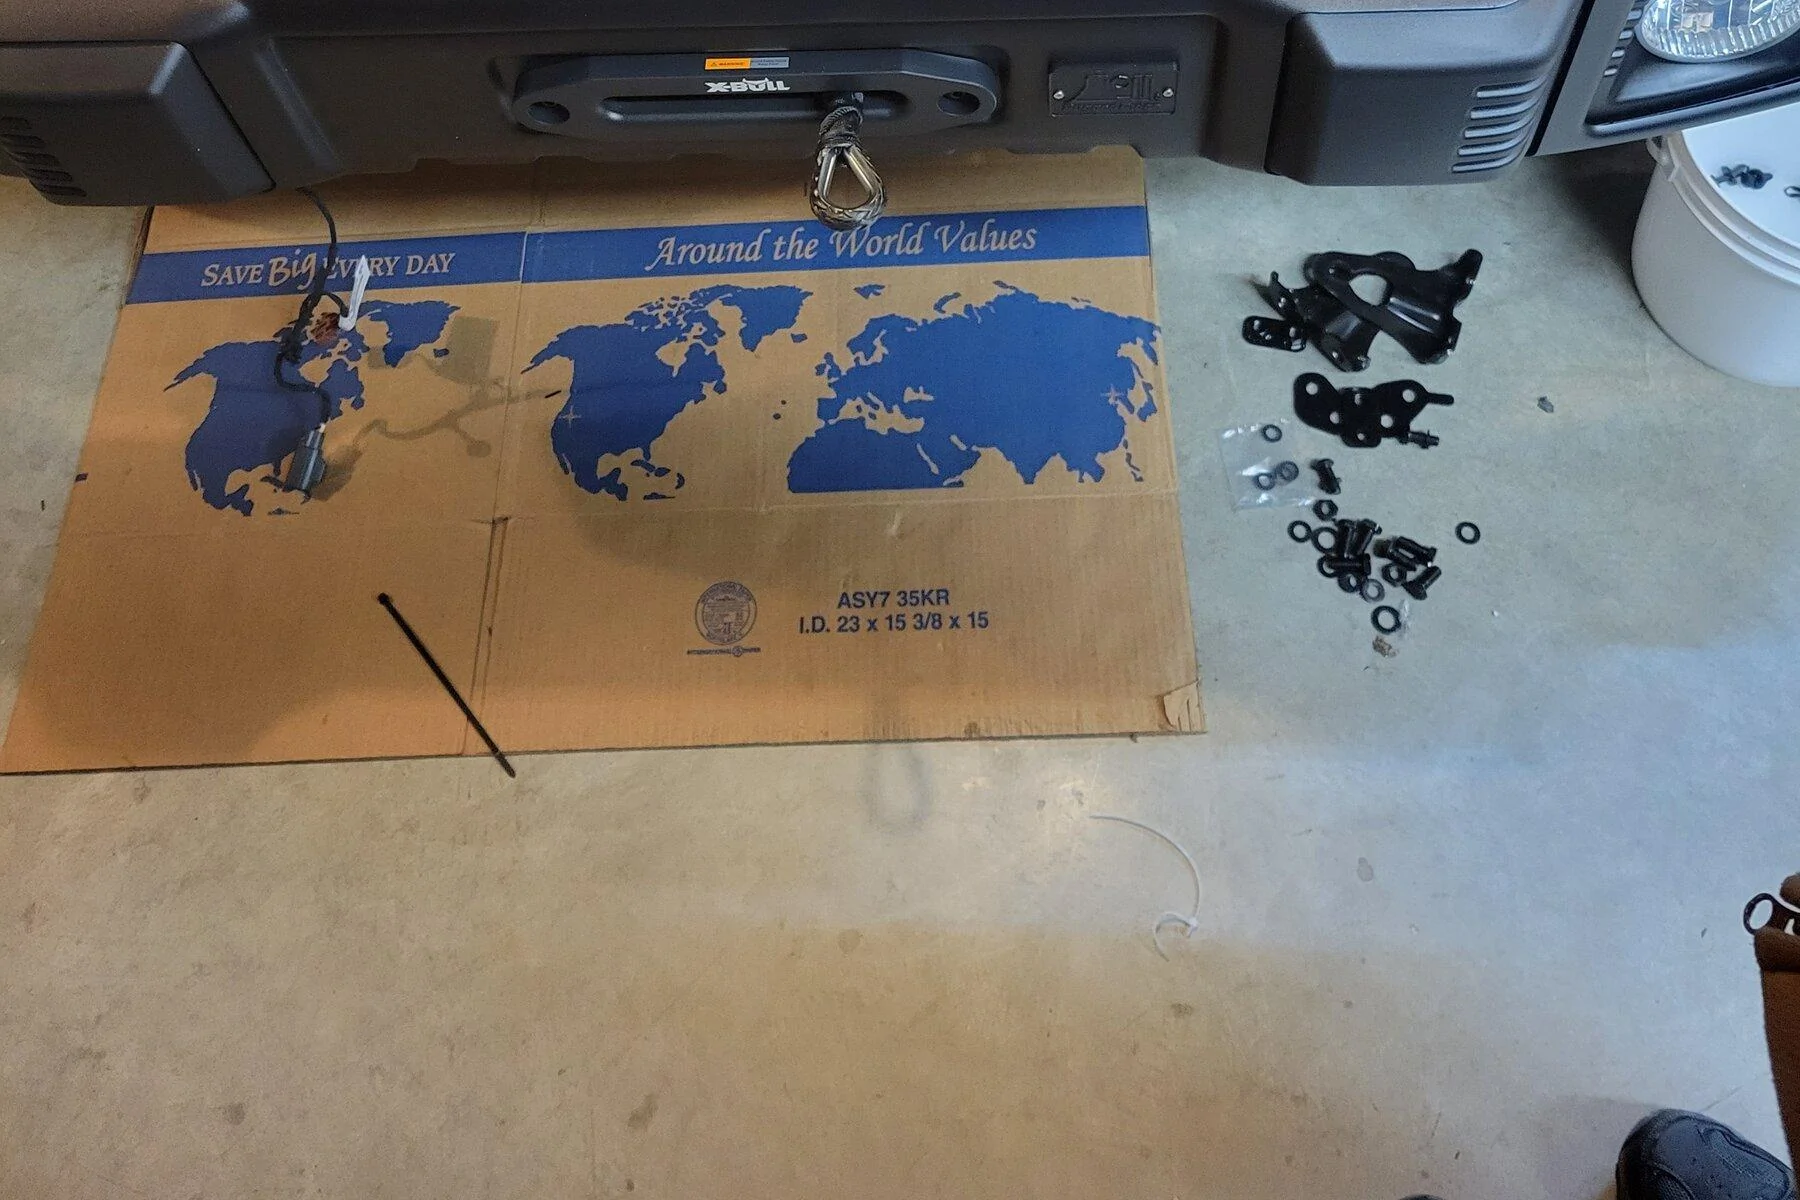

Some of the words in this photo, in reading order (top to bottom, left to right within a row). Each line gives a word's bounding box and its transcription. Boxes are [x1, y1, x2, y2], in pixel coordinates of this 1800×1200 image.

[705, 79, 791, 93] X-BULL
[645, 228, 772, 271] Around
[773, 227, 818, 261] the
[829, 217, 932, 258] World
[934, 219, 1038, 253] Values
[201, 263, 264, 287] SAVE
[268, 249, 317, 291] Big
[405, 253, 455, 275] DAY
[837, 591, 891, 609] ASY7
[896, 588, 950, 607] 35KR
[799, 616, 830, 634] I.D.
[837, 615, 860, 633] 23
[867, 618, 878, 632] x
[885, 614, 906, 631] 15
[913, 612, 943, 631] 3/8
[949, 616, 961, 630] x
[967, 611, 989, 629] 15
